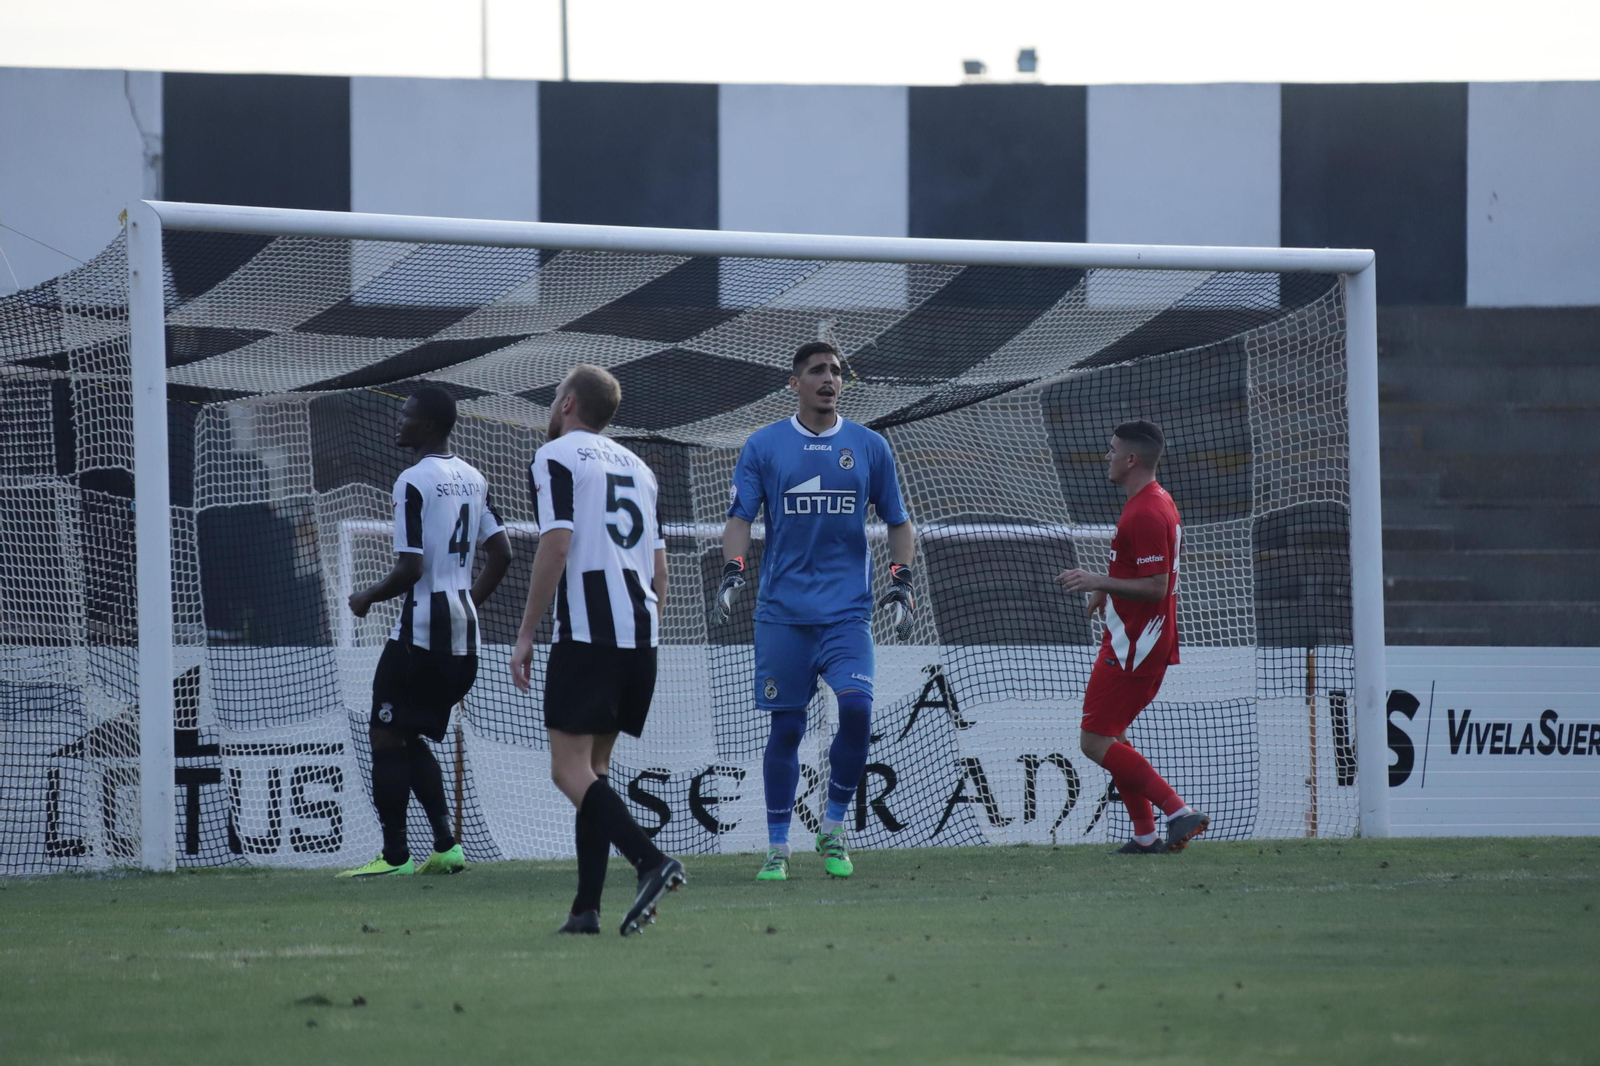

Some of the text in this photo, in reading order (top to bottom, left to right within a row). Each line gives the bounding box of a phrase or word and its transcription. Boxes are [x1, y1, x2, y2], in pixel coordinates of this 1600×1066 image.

[605, 473, 644, 549] 5
[784, 496, 855, 515] LOTUS
[449, 503, 470, 567] 4
[1139, 554, 1164, 564] betfair
